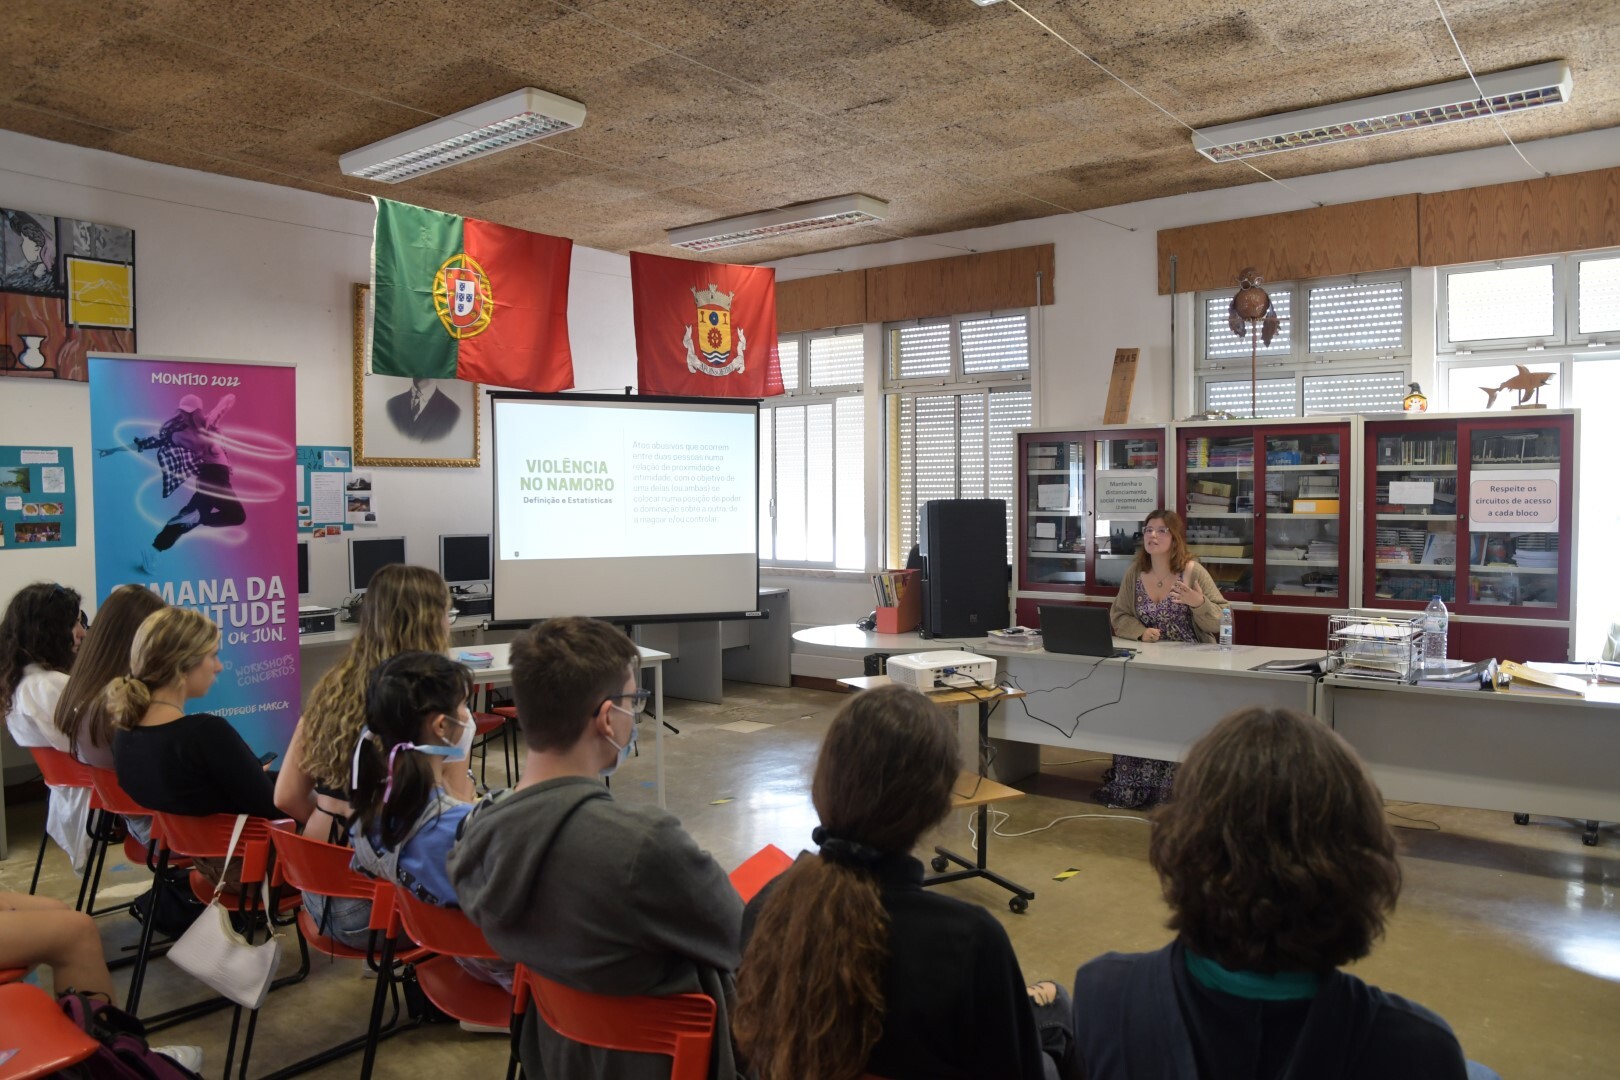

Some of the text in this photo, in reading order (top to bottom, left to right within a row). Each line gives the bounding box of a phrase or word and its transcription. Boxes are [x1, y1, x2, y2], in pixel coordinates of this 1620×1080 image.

[151, 372, 241, 387] MONTIJO 2022
[632, 441, 650, 449] Atos
[651, 441, 684, 450] abusivos
[685, 444, 699, 452] que
[525, 457, 608, 474] VIOLÊNCIA
[632, 463, 659, 471] relação
[671, 464, 714, 472] proximidade
[696, 474, 725, 483] objetivo
[726, 473, 736, 482] de
[520, 477, 615, 491] NO NAMORO
[650, 484, 670, 492] delas
[671, 484, 683, 493] (ou
[684, 484, 710, 493] ambas)
[1490, 485, 1525, 493] Respeite
[523, 496, 560, 505] Definição
[567, 496, 613, 504] Estatísticas
[682, 494, 710, 504] posição
[711, 494, 721, 502] de
[721, 494, 741, 503] poder
[639, 505, 679, 514] dominação
[1494, 509, 1514, 517] cada
[1516, 509, 1539, 517] bloco
[639, 517, 667, 525] magoar
[668, 515, 685, 523] e/ou
[111, 575, 286, 606] MANA DA
[227, 626, 287, 645] 04 JUN.
[235, 654, 295, 677] WORKSHOPS
[237, 664, 296, 687] CONCERTOS
[258, 700, 290, 713] MARCA
